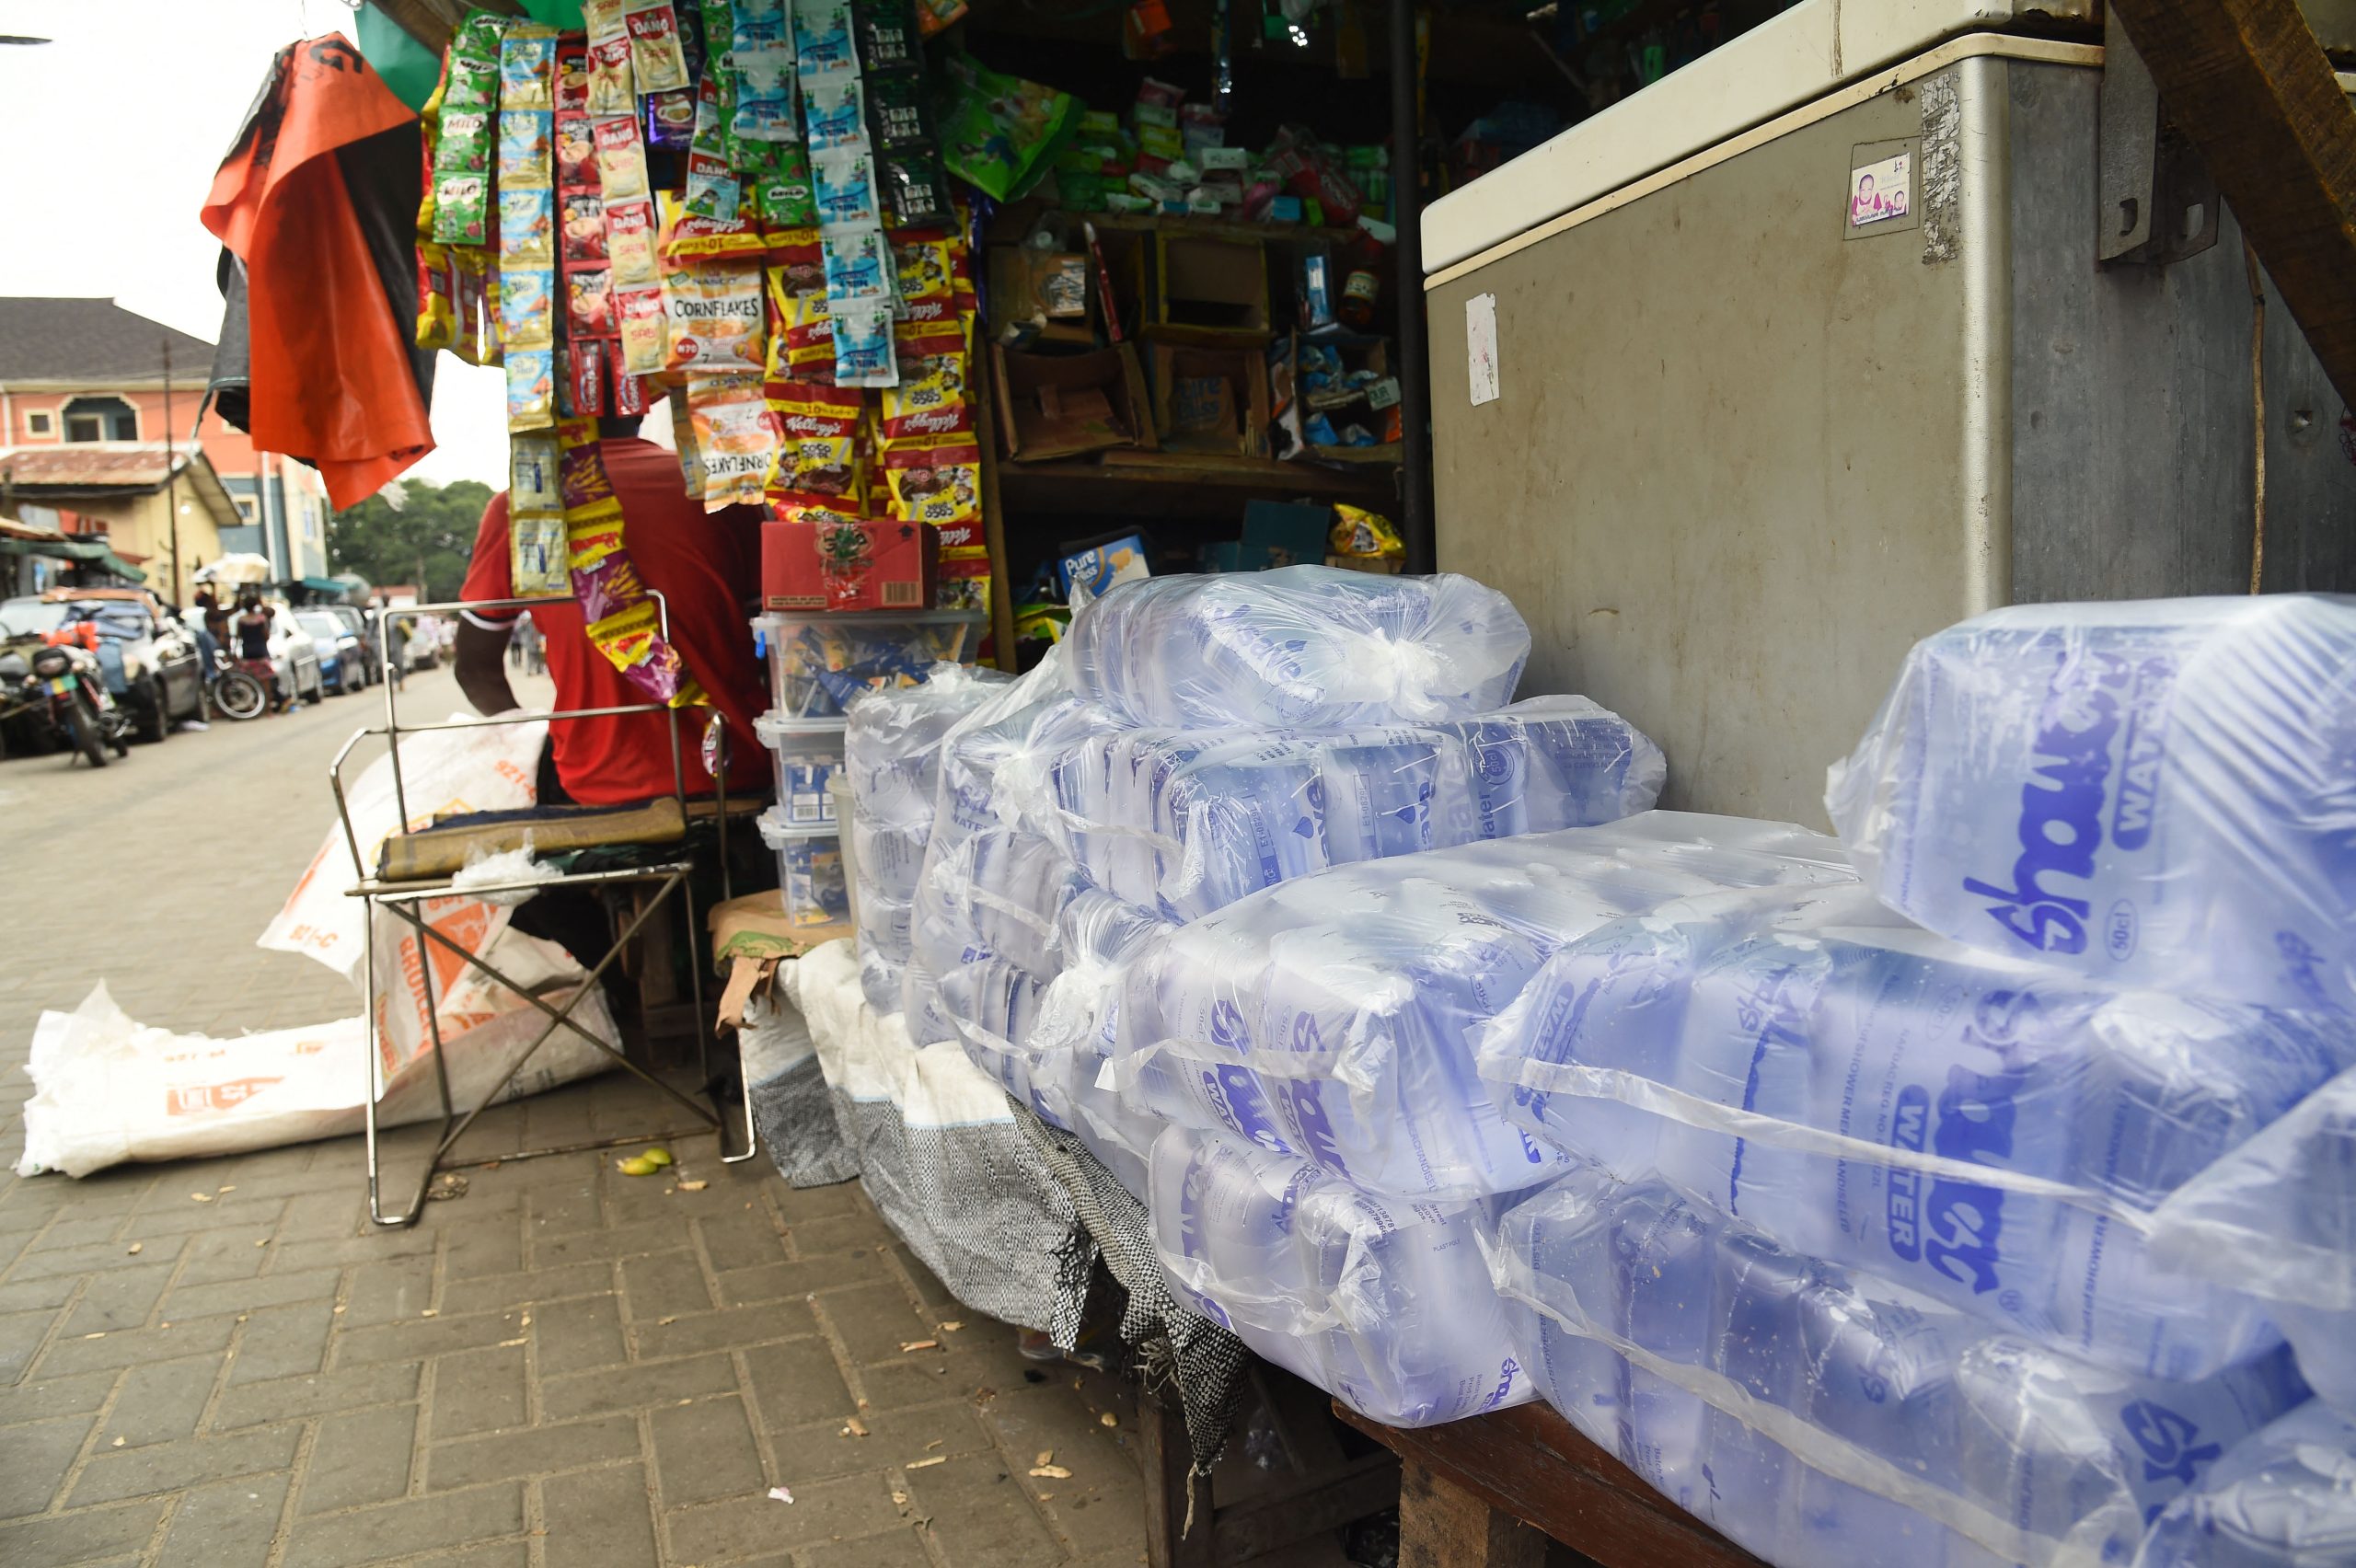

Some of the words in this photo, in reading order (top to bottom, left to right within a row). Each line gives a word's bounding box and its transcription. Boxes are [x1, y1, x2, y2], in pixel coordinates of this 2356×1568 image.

[635, 19, 669, 34] DANO
[601, 127, 633, 145] DANO
[696, 162, 732, 178] DANO
[611, 215, 646, 230] DANO
[625, 299, 660, 314] DANO
[675, 298, 759, 319] CORNFLAKES
[786, 415, 842, 437] Kellogg's
[904, 413, 960, 431] Kellogg's
[703, 451, 775, 478] ORNFLAKES
[1065, 551, 1096, 576] Pure
[1486, 751, 1501, 774] 50cl
[1360, 785, 1370, 827] E1-0829L
[1249, 808, 1270, 847] E1-0829L
[1427, 1202, 1448, 1228] Street
